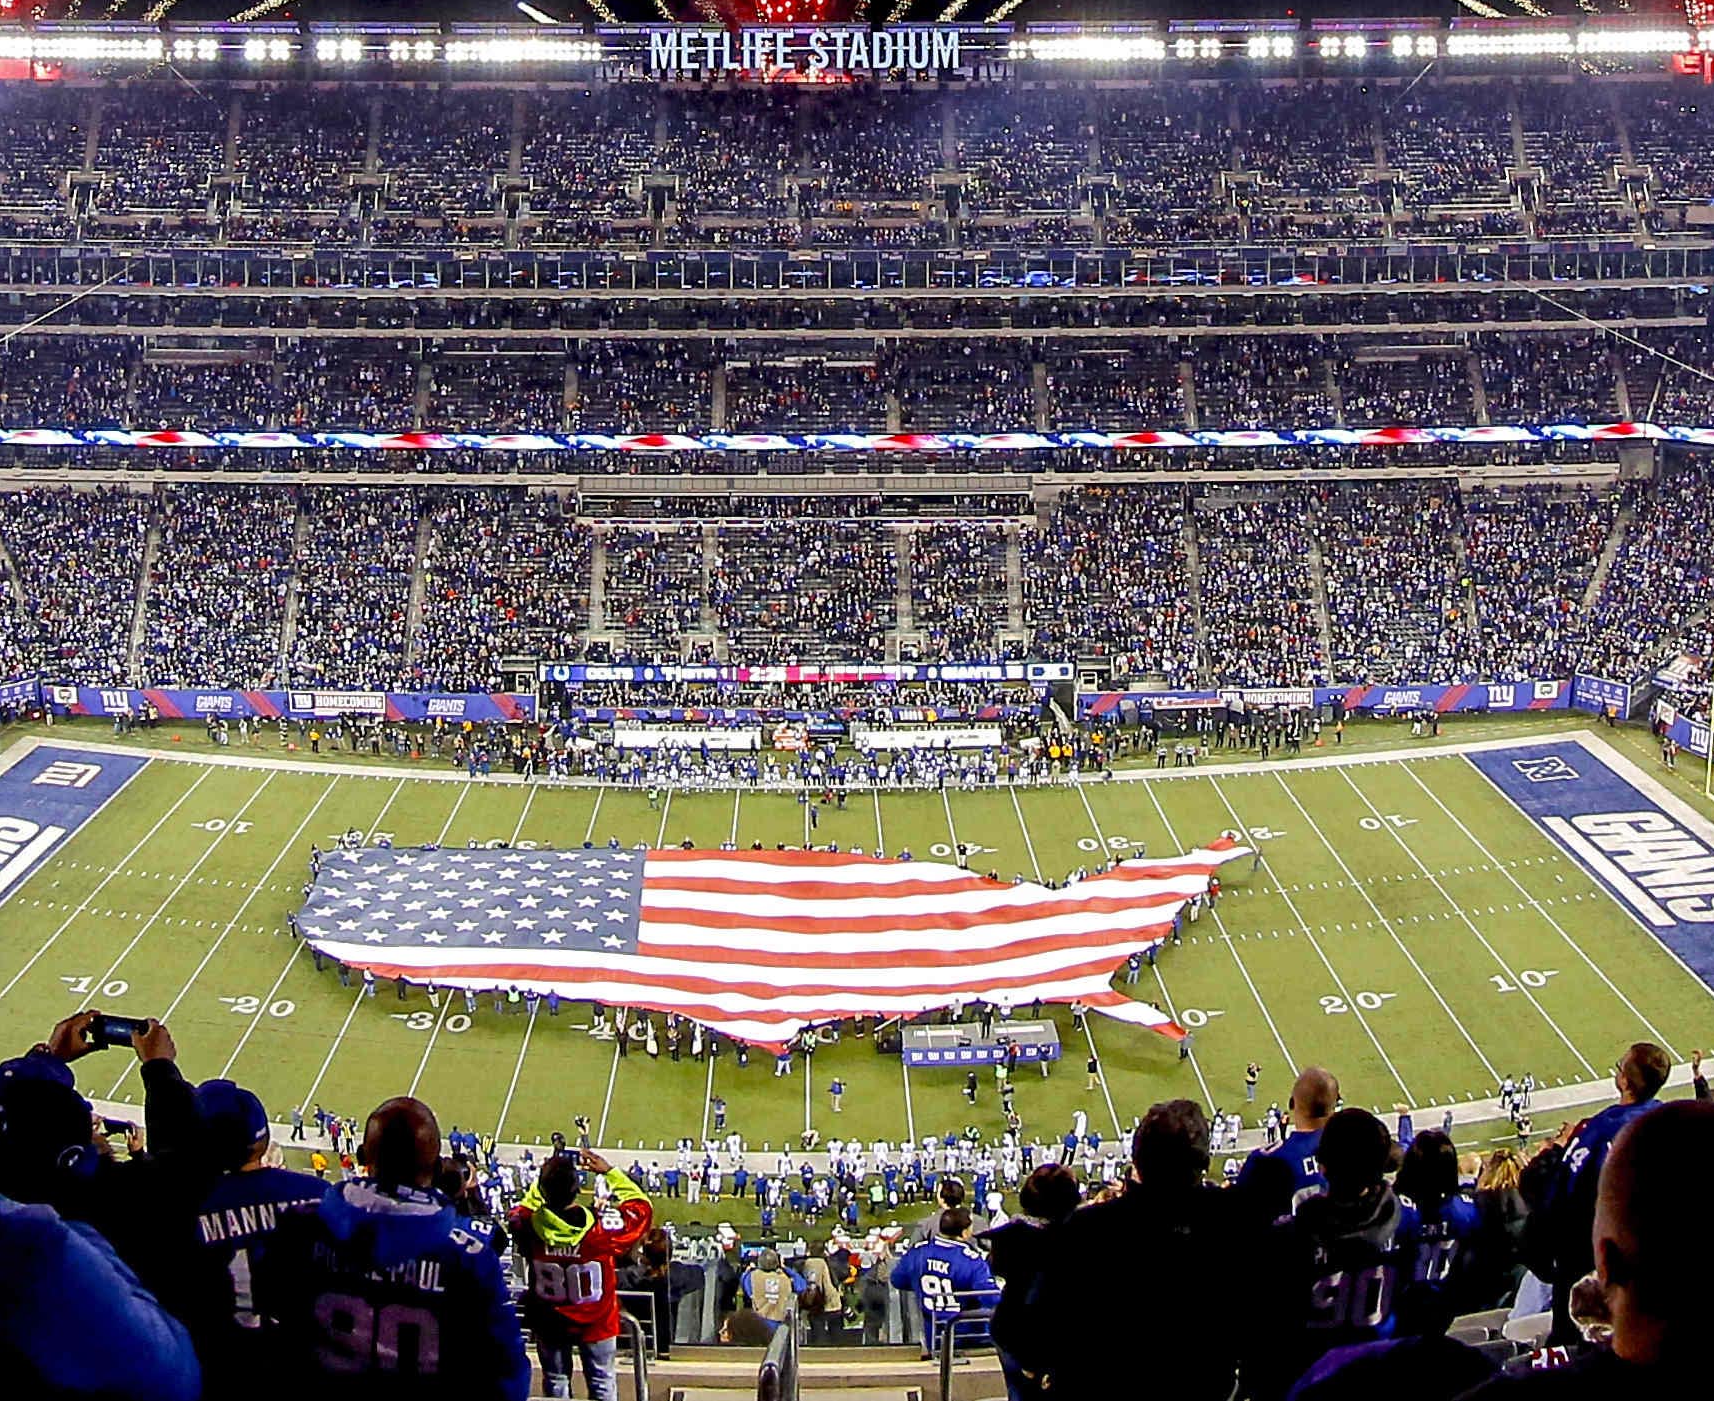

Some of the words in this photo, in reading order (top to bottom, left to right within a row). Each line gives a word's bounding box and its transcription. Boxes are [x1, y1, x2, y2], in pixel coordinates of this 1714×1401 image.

[649, 31, 796, 70] METLIFE
[809, 31, 960, 70] STADIUM
[315, 693, 383, 710] HOMECOMING
[426, 698, 466, 714] GIANTS
[1243, 691, 1311, 705] HOMECOMING
[1383, 691, 1420, 705] GIANTS
[67, 975, 130, 998] 10
[1489, 970, 1548, 994] 10
[229, 996, 297, 1018] 20
[1319, 990, 1384, 1016] 20
[405, 1011, 473, 1033] 30
[533, 1258, 604, 1306] 80
[920, 1274, 961, 1313] 91
